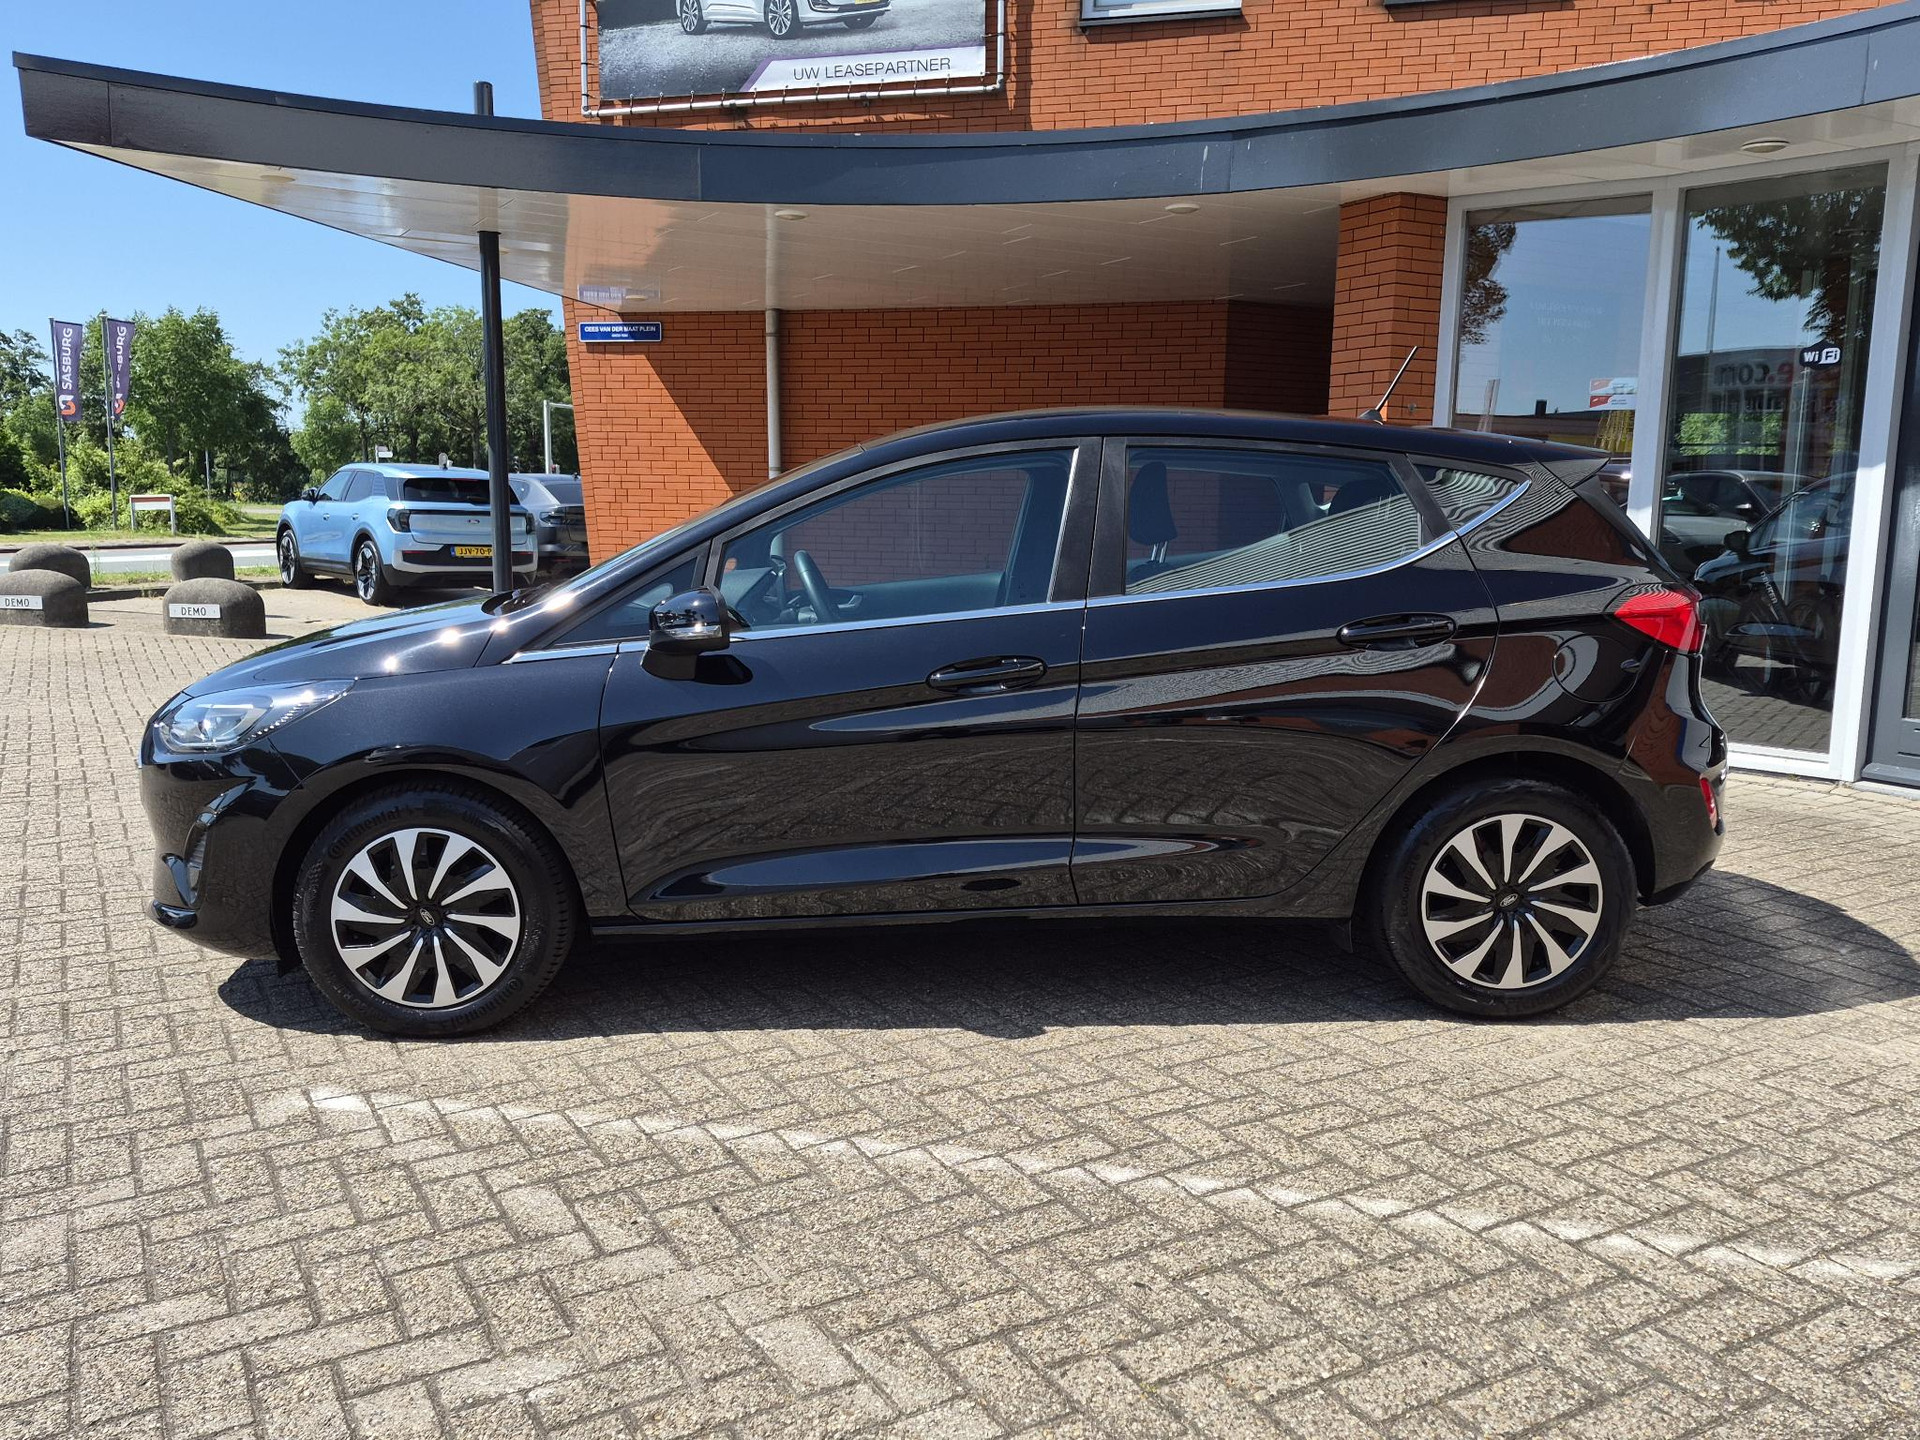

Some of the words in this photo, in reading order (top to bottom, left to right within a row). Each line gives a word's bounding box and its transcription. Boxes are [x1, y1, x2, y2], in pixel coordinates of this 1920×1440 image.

[793, 65, 821, 81] UW
[826, 57, 951, 79] LEASEPARTNER
[61, 327, 73, 390] SASBURG
[4, 598, 30, 608] DEMO
[181, 606, 207, 616] DEMO
